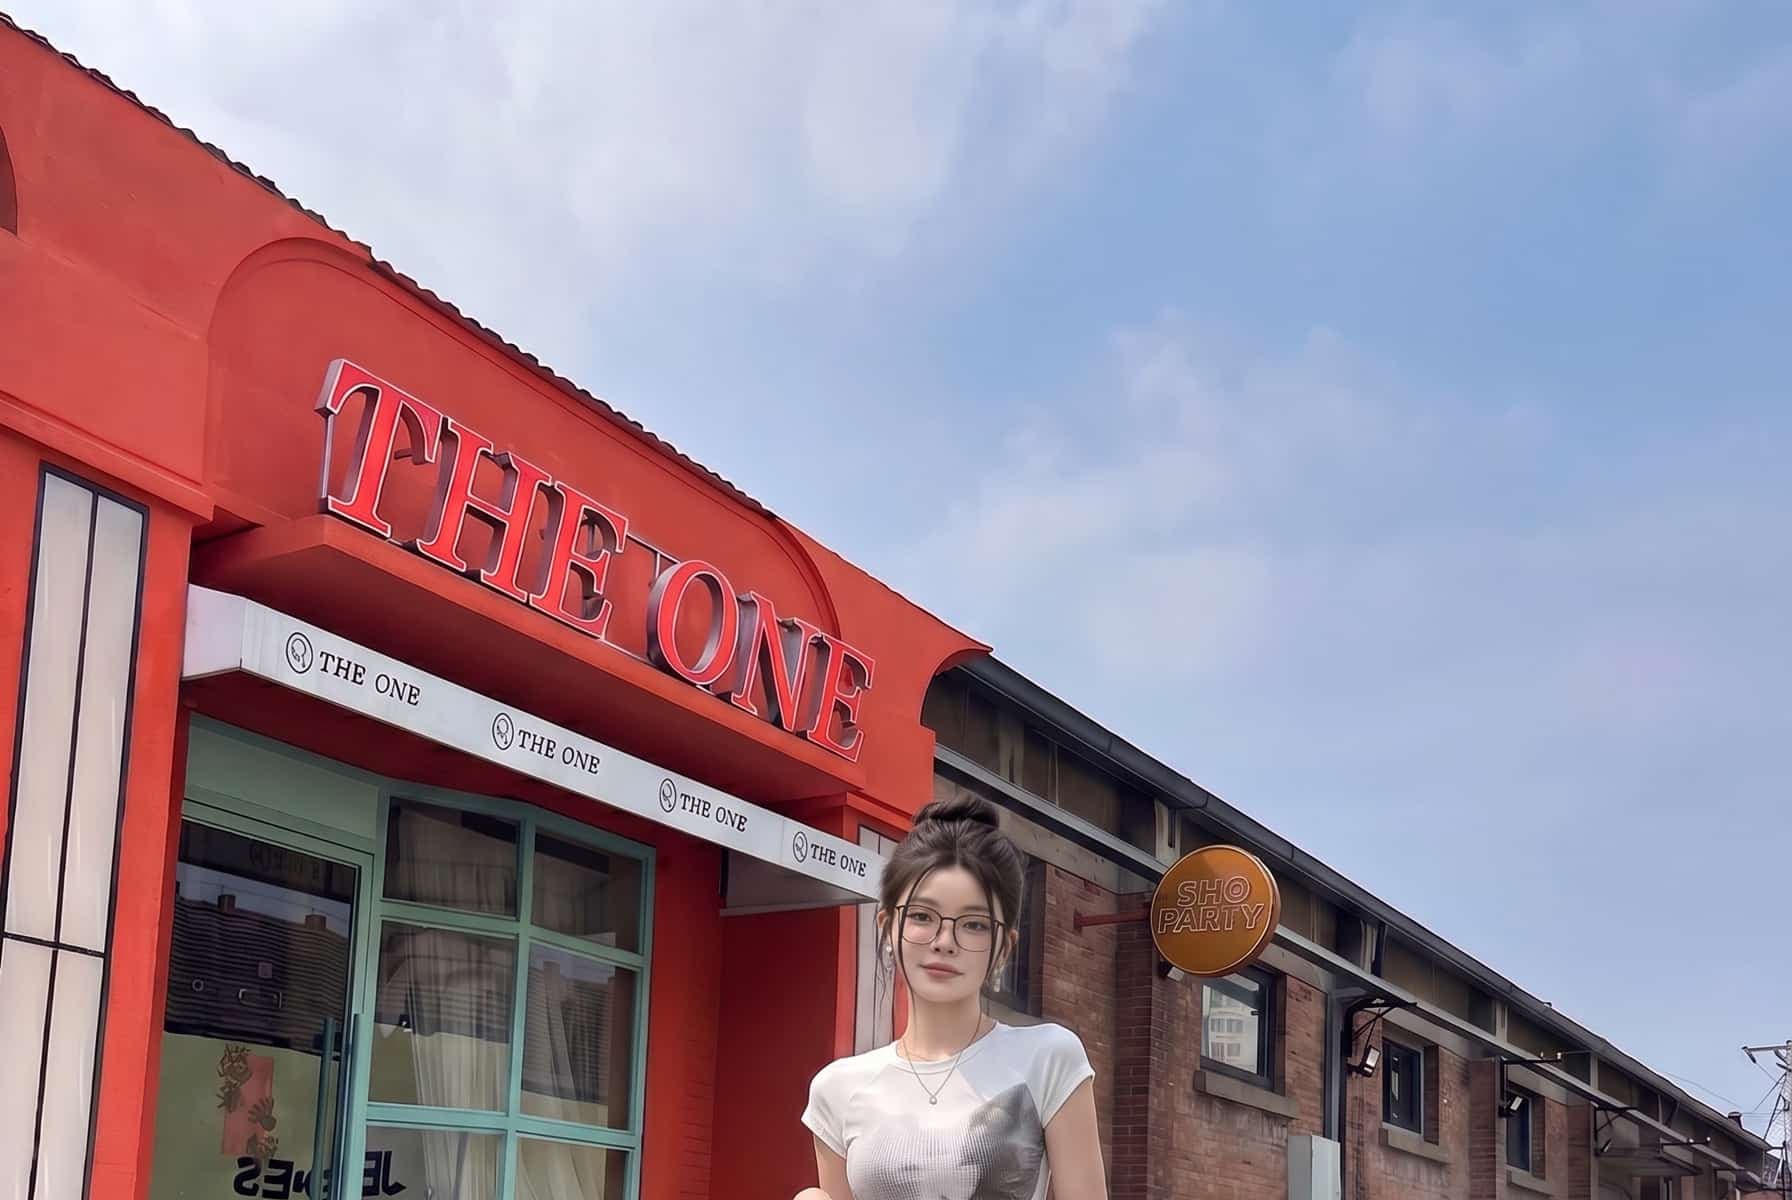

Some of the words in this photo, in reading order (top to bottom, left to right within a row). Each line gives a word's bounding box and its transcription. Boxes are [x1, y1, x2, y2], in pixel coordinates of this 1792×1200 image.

[316, 359, 630, 642] THE
[647, 559, 876, 762] ONE
[319, 651, 366, 686] THE
[375, 673, 421, 706] ONE
[518, 729, 556, 759] THE
[562, 746, 600, 774] ONE
[680, 792, 711, 818] THE
[715, 806, 748, 832] ONE
[810, 843, 836, 866] THE
[840, 854, 867, 877] ONE
[1177, 875, 1250, 907] SHO
[1158, 903, 1264, 934] PARTY
